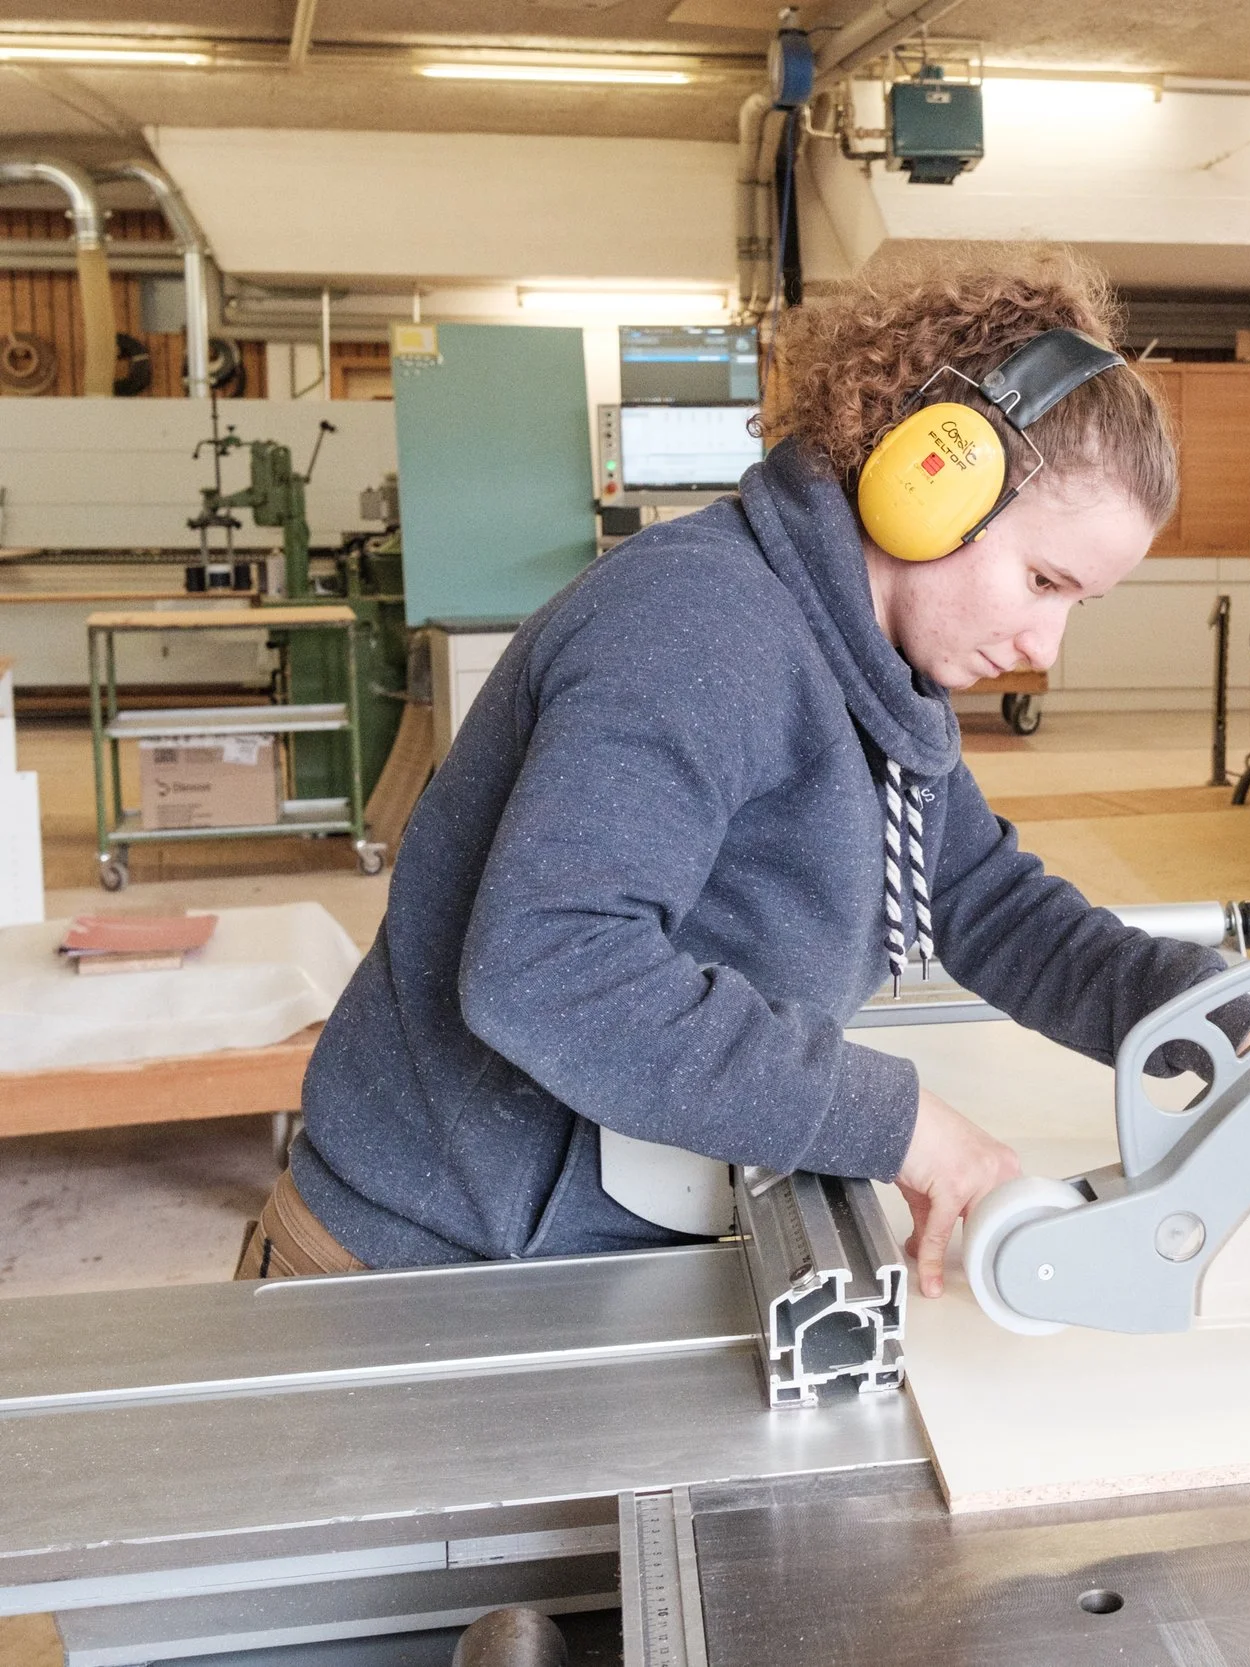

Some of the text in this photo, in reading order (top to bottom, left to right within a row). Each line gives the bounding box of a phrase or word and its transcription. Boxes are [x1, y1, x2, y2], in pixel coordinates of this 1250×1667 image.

[928, 430, 967, 471] PELTOR
[657, 1607, 669, 1617] 10
[660, 1646, 669, 1654] 13
